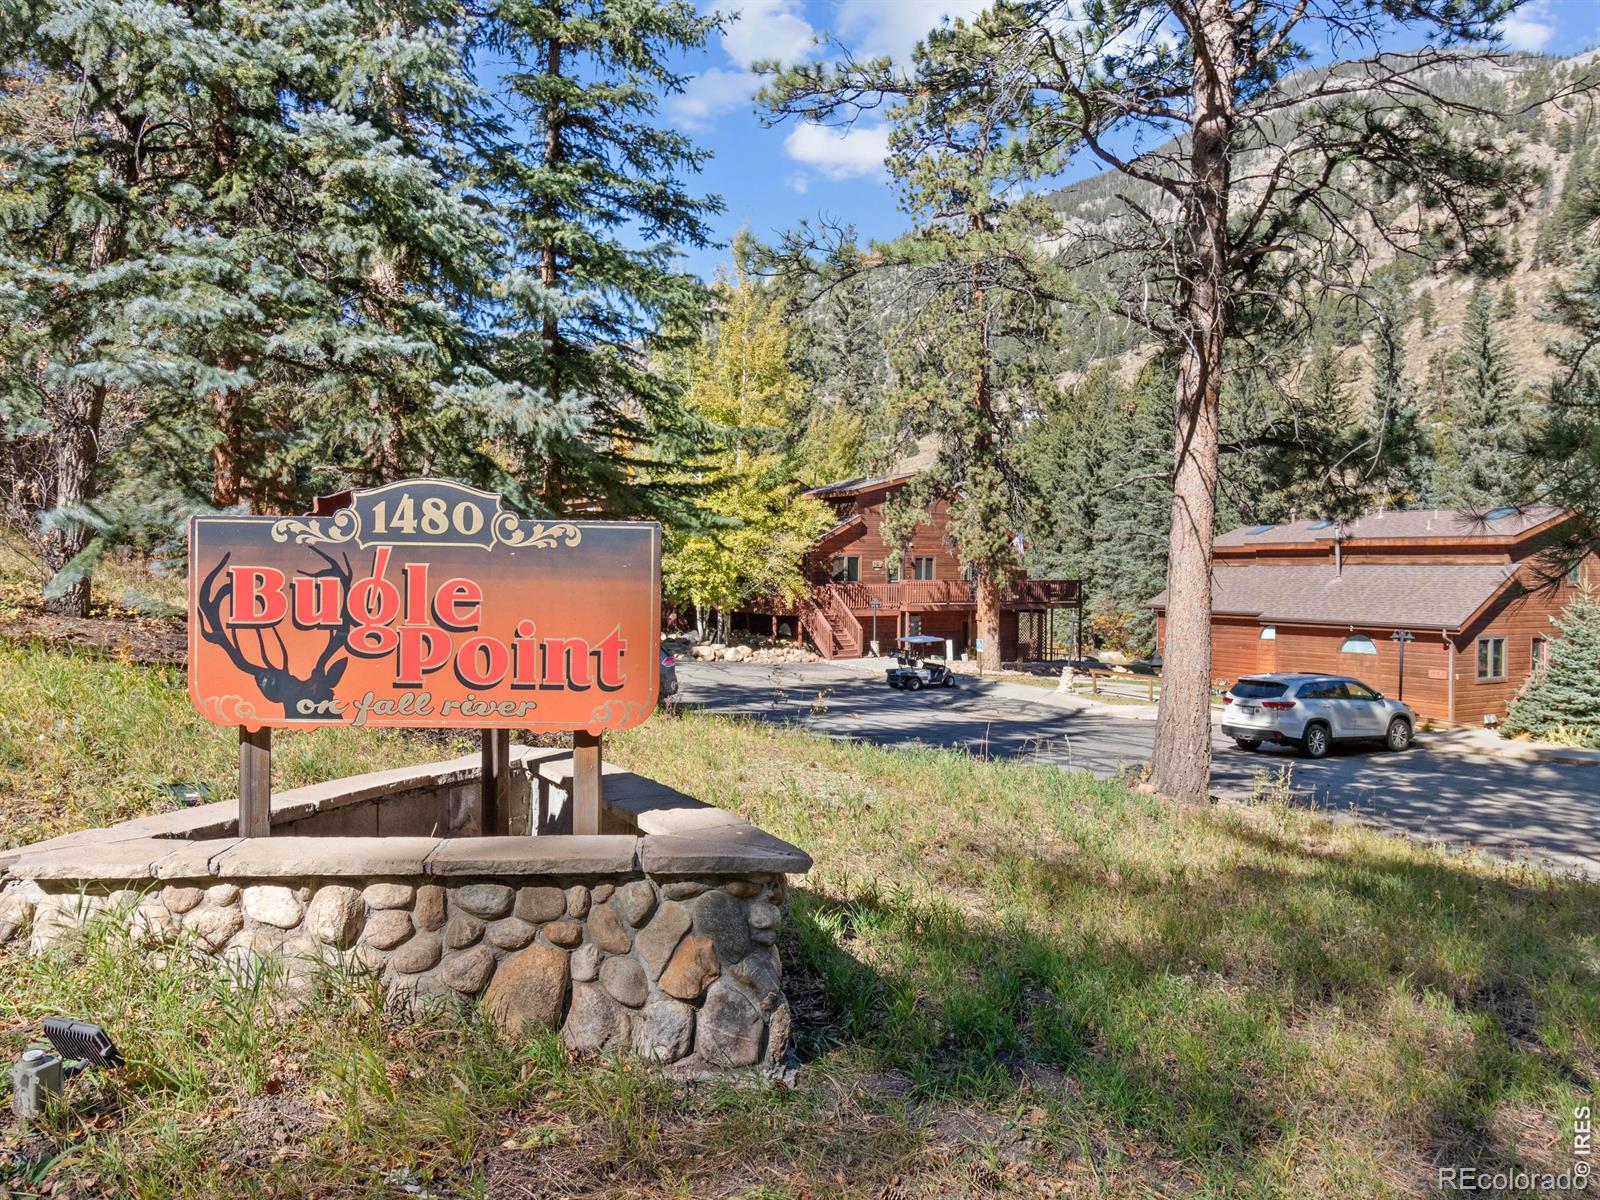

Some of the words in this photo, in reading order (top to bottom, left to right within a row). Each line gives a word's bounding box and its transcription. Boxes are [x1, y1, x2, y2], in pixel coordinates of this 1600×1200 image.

[371, 493, 485, 535] 1480
[227, 546, 483, 658] Bugle
[393, 619, 628, 690] Point
[296, 699, 350, 715] on
[351, 691, 434, 726] fall
[440, 694, 537, 717] river
